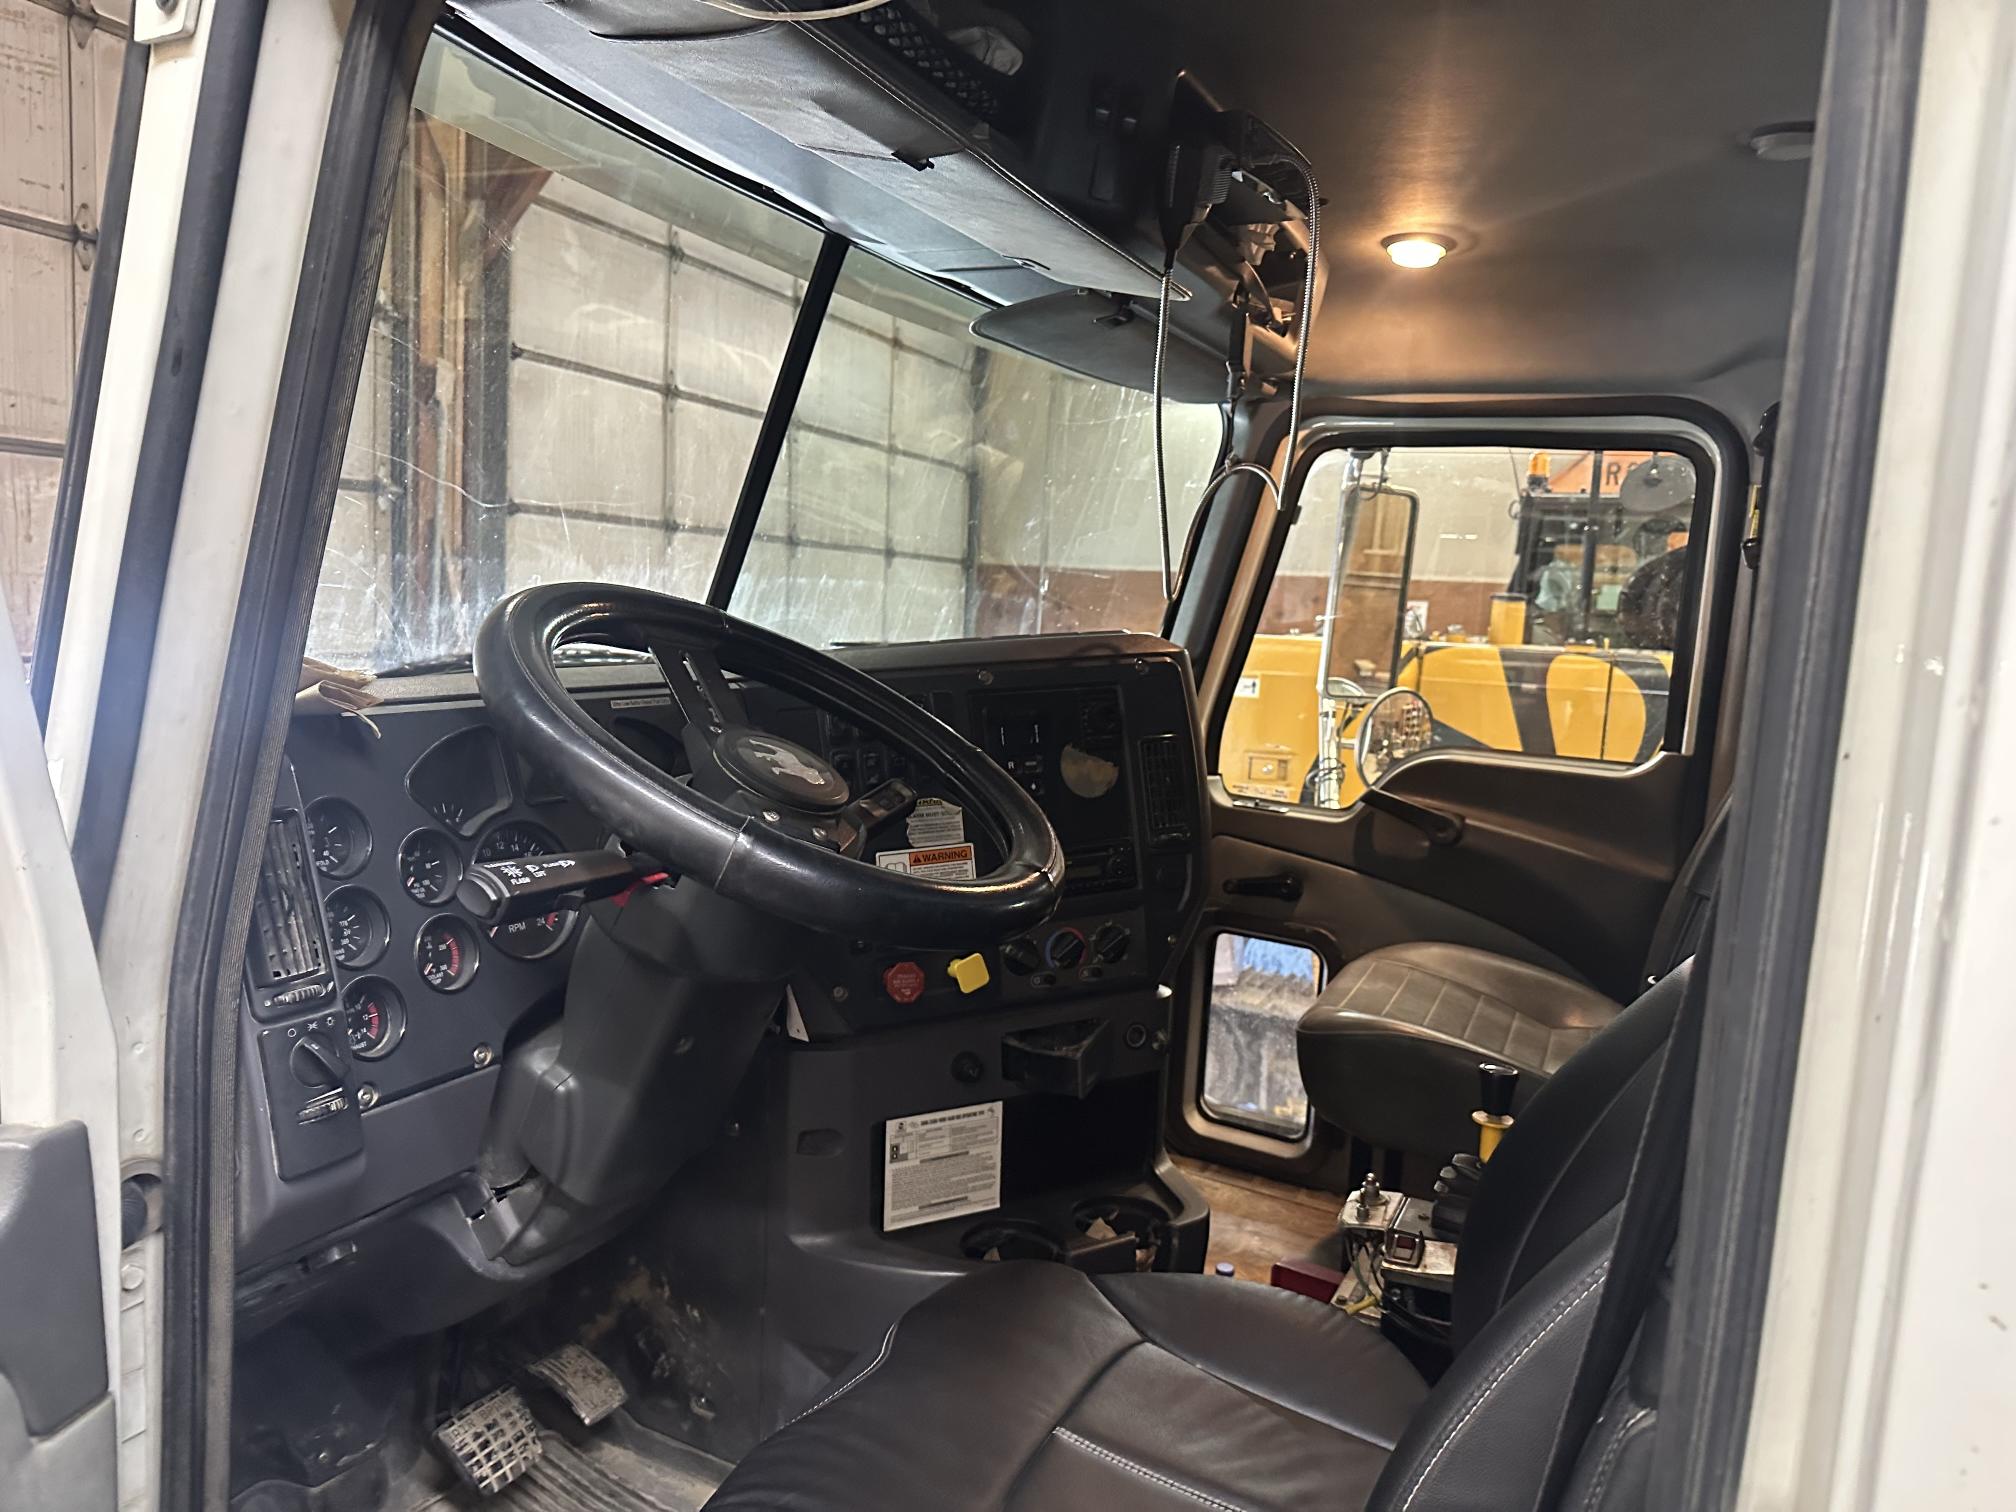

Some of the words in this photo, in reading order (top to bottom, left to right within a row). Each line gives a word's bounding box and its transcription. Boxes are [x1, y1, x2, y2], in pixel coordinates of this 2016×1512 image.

[511, 844, 520, 852] 14
[922, 849, 968, 862] WARNING
[508, 922, 526, 933] RPM
